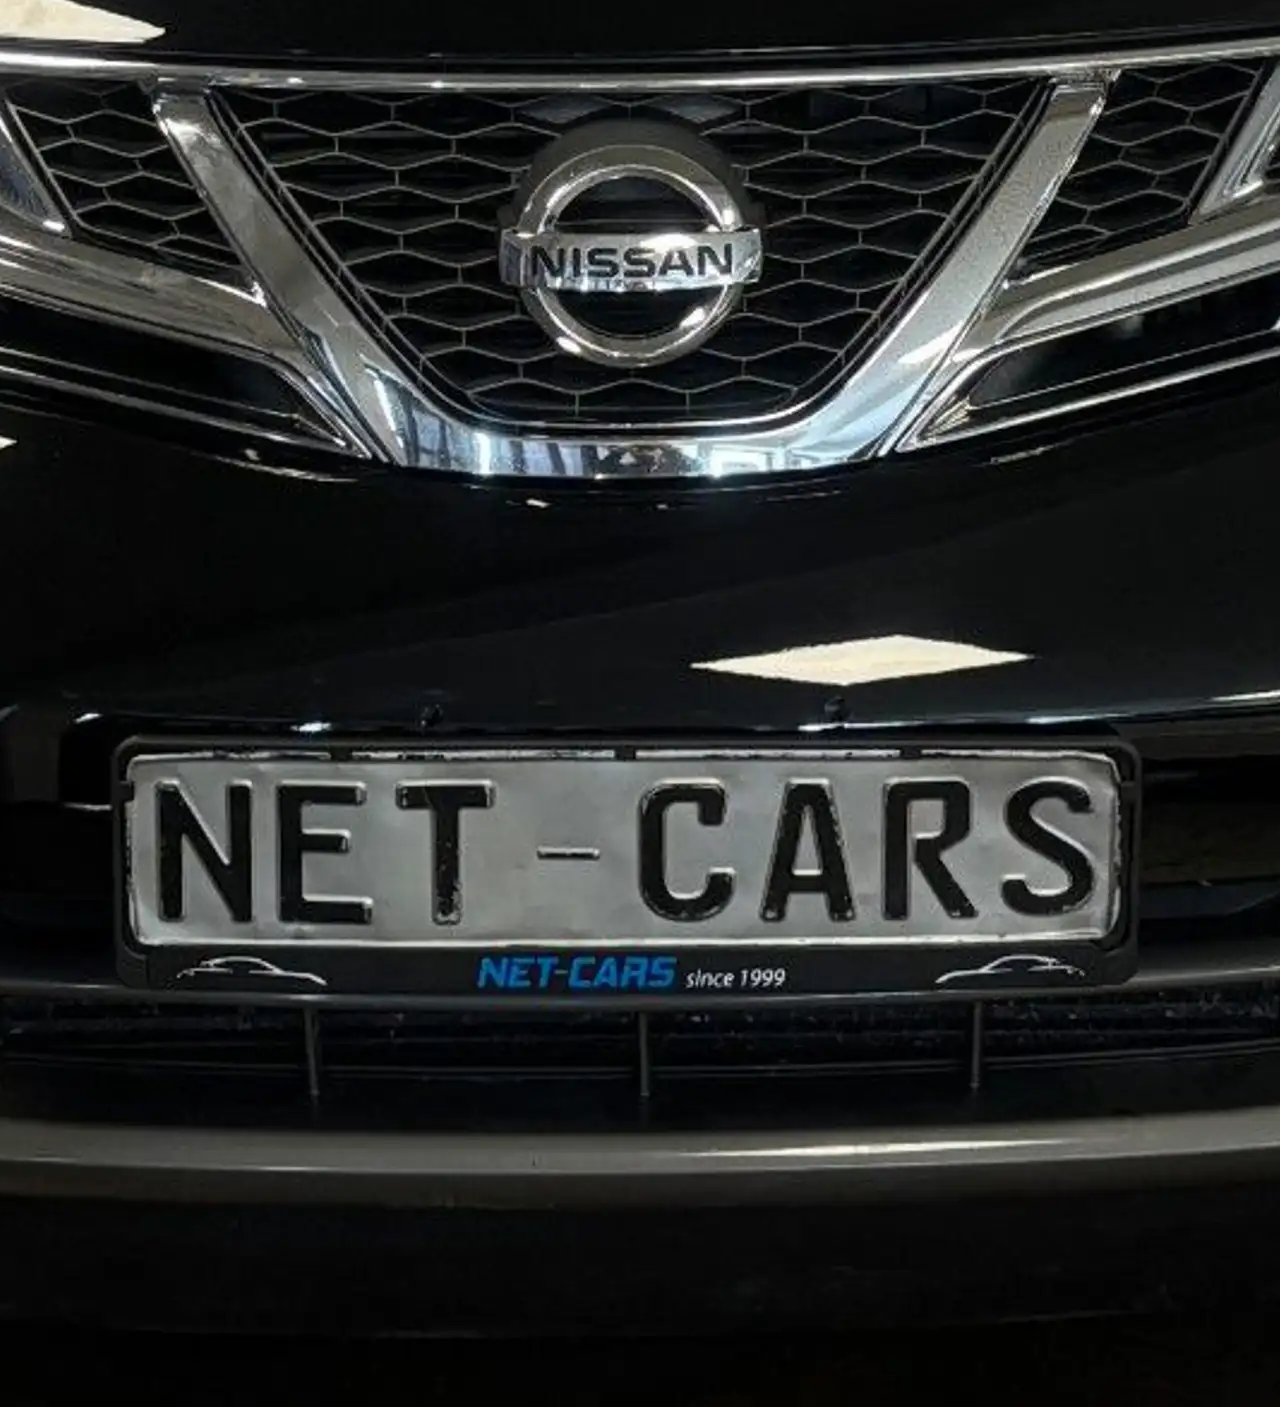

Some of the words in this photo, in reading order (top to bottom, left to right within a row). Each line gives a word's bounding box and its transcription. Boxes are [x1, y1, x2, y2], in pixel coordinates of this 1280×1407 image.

[531, 243, 732, 278] NISSAN
[477, 956, 677, 988] NET-CARS
[685, 969, 734, 988] since
[740, 968, 786, 987] 1999
